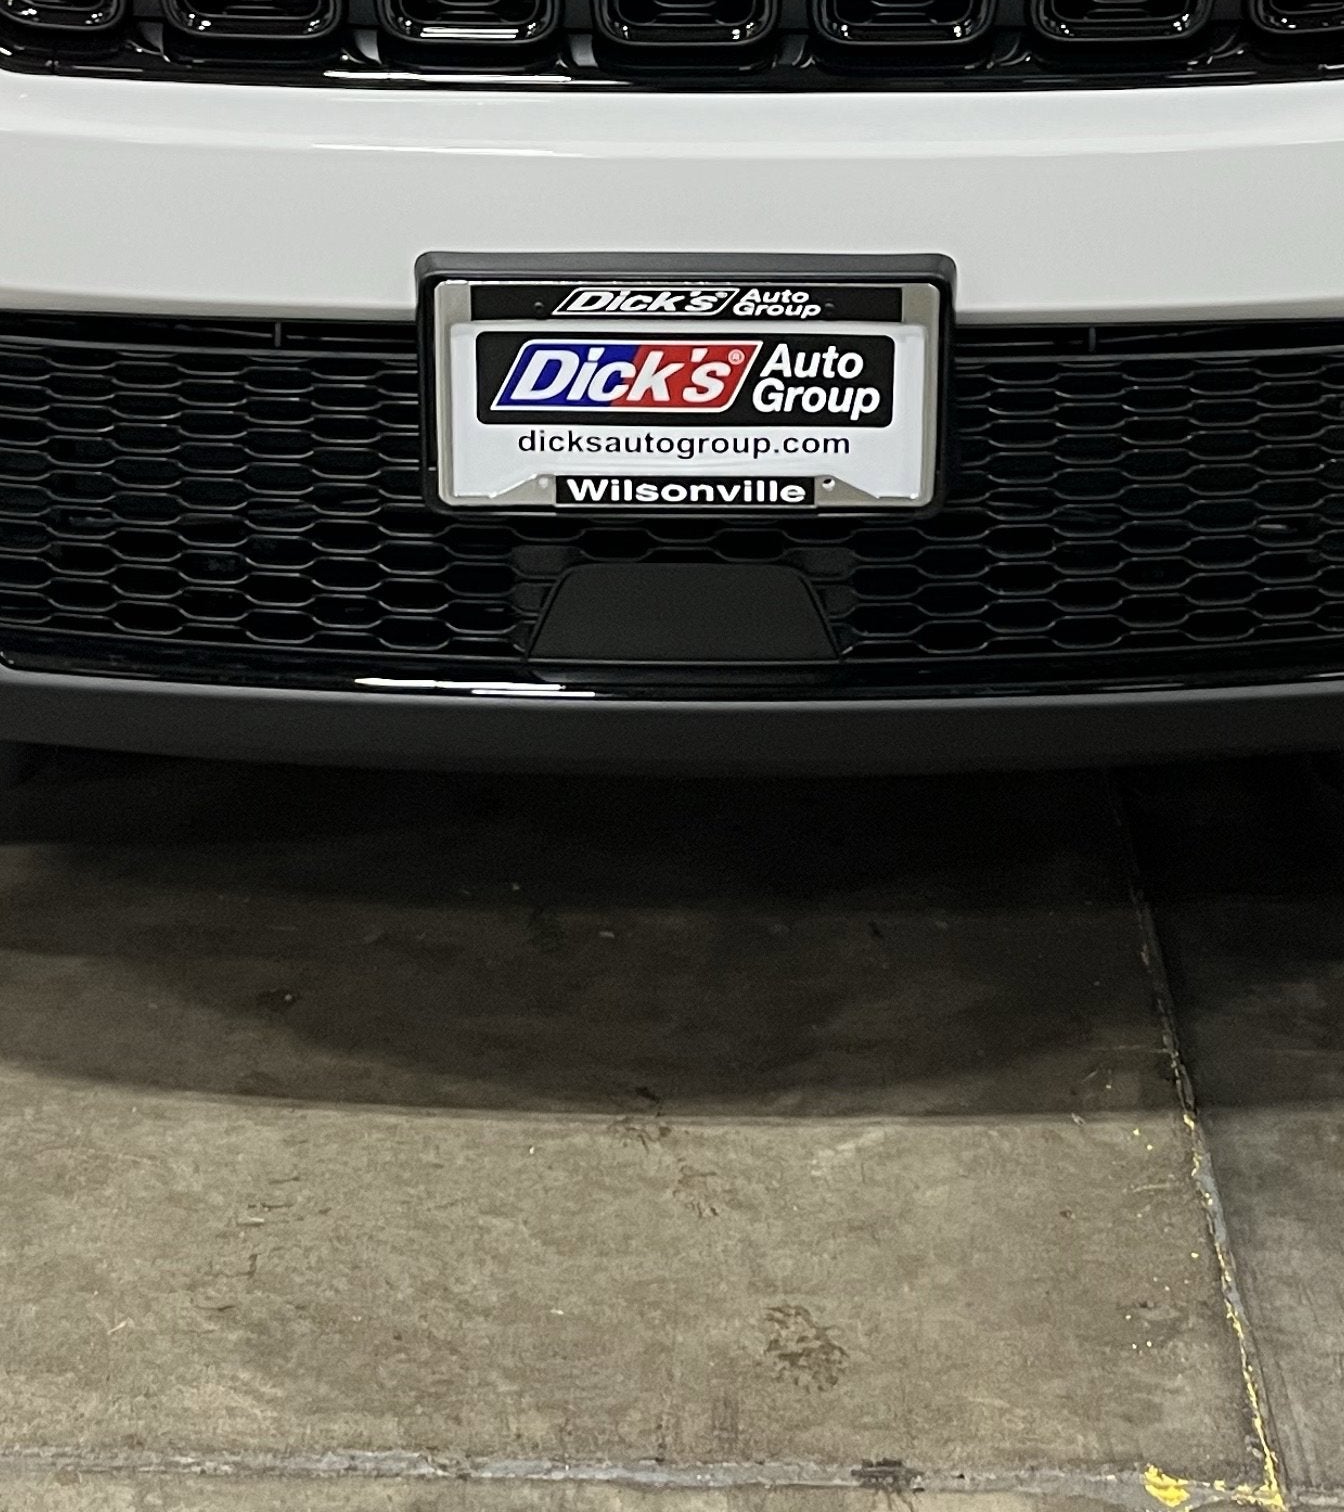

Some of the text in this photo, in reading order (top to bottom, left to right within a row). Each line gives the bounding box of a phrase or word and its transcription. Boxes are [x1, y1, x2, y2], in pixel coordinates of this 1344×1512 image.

[565, 289, 719, 311] Dick's
[733, 300, 822, 319] Group
[739, 289, 810, 304] Auto
[760, 343, 863, 379] Auto
[510, 347, 732, 403] Dick's
[752, 378, 881, 421] Group
[518, 430, 850, 459] dicksautogroup.com
[567, 478, 806, 504] Wilsonville
